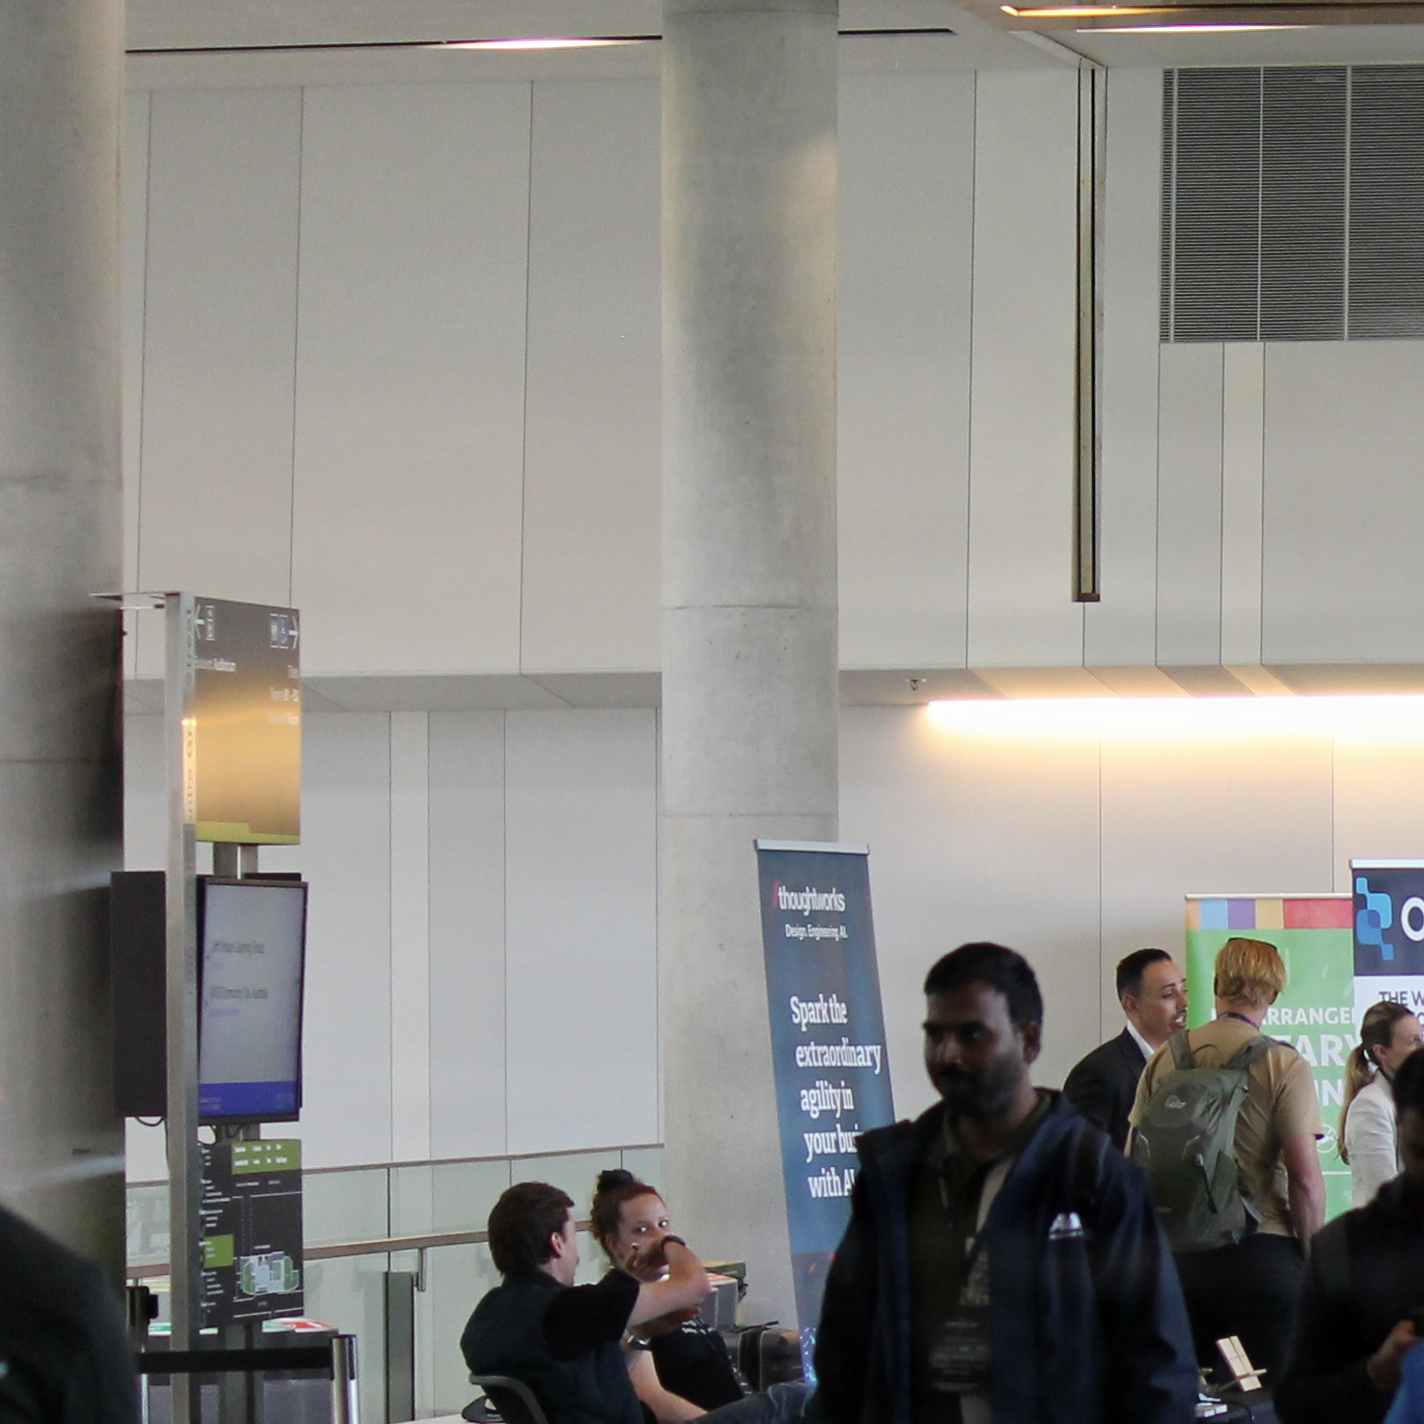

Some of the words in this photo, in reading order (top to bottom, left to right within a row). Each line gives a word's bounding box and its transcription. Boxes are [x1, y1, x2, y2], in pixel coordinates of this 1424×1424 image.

[790, 994, 830, 1031] Spark
[829, 994, 849, 1024] the
[1378, 990, 1407, 1007] THE
[795, 1037, 882, 1074] extraordinary
[801, 1080, 841, 1119] agility
[841, 1080, 855, 1110] in
[804, 1131, 837, 1164] your
[808, 1167, 842, 1199] with
